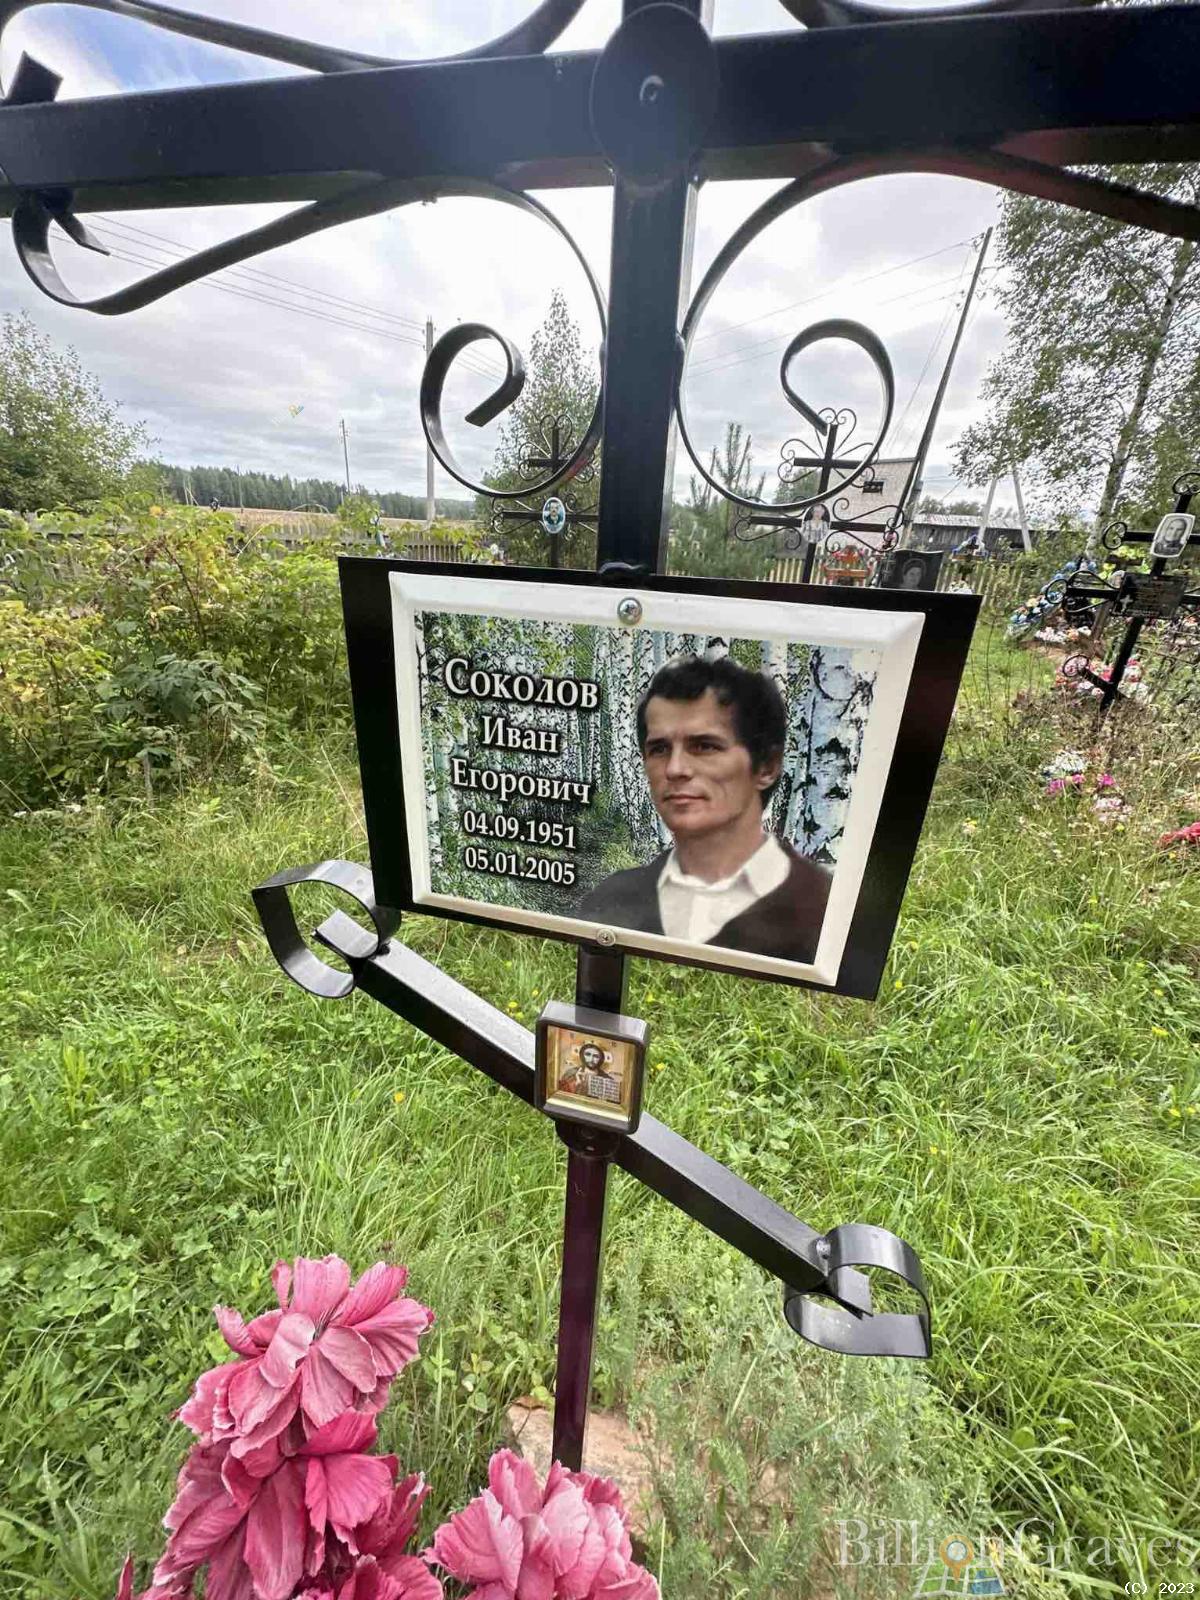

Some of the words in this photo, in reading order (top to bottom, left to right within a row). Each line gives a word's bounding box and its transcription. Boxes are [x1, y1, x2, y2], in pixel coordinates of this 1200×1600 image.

[482, 715, 559, 753] Иван
[452, 758, 590, 803] Егорович
[463, 810, 576, 849] 04.09.1951
[465, 847, 576, 885] 05.01.2005
